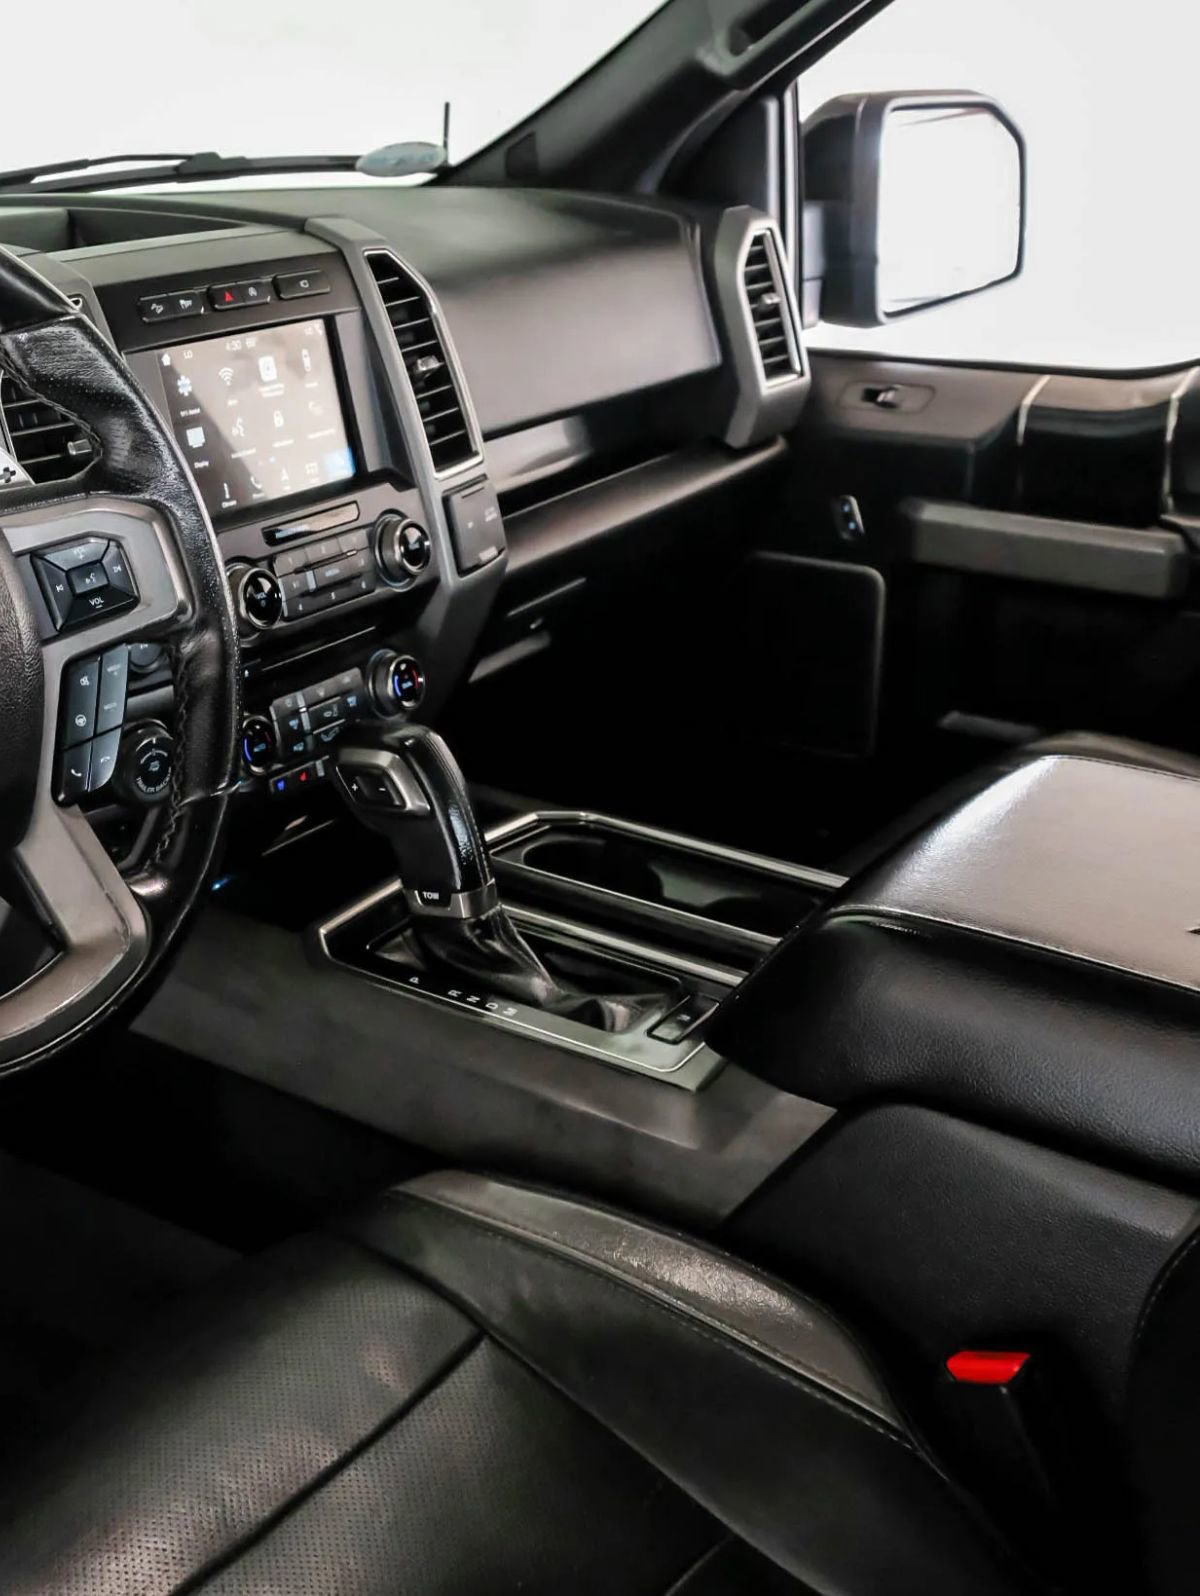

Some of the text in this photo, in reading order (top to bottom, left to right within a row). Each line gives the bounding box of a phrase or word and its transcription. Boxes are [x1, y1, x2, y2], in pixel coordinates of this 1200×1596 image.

[89, 596, 104, 606] VOL
[447, 989, 462, 997] R
[466, 995, 480, 1003] N
